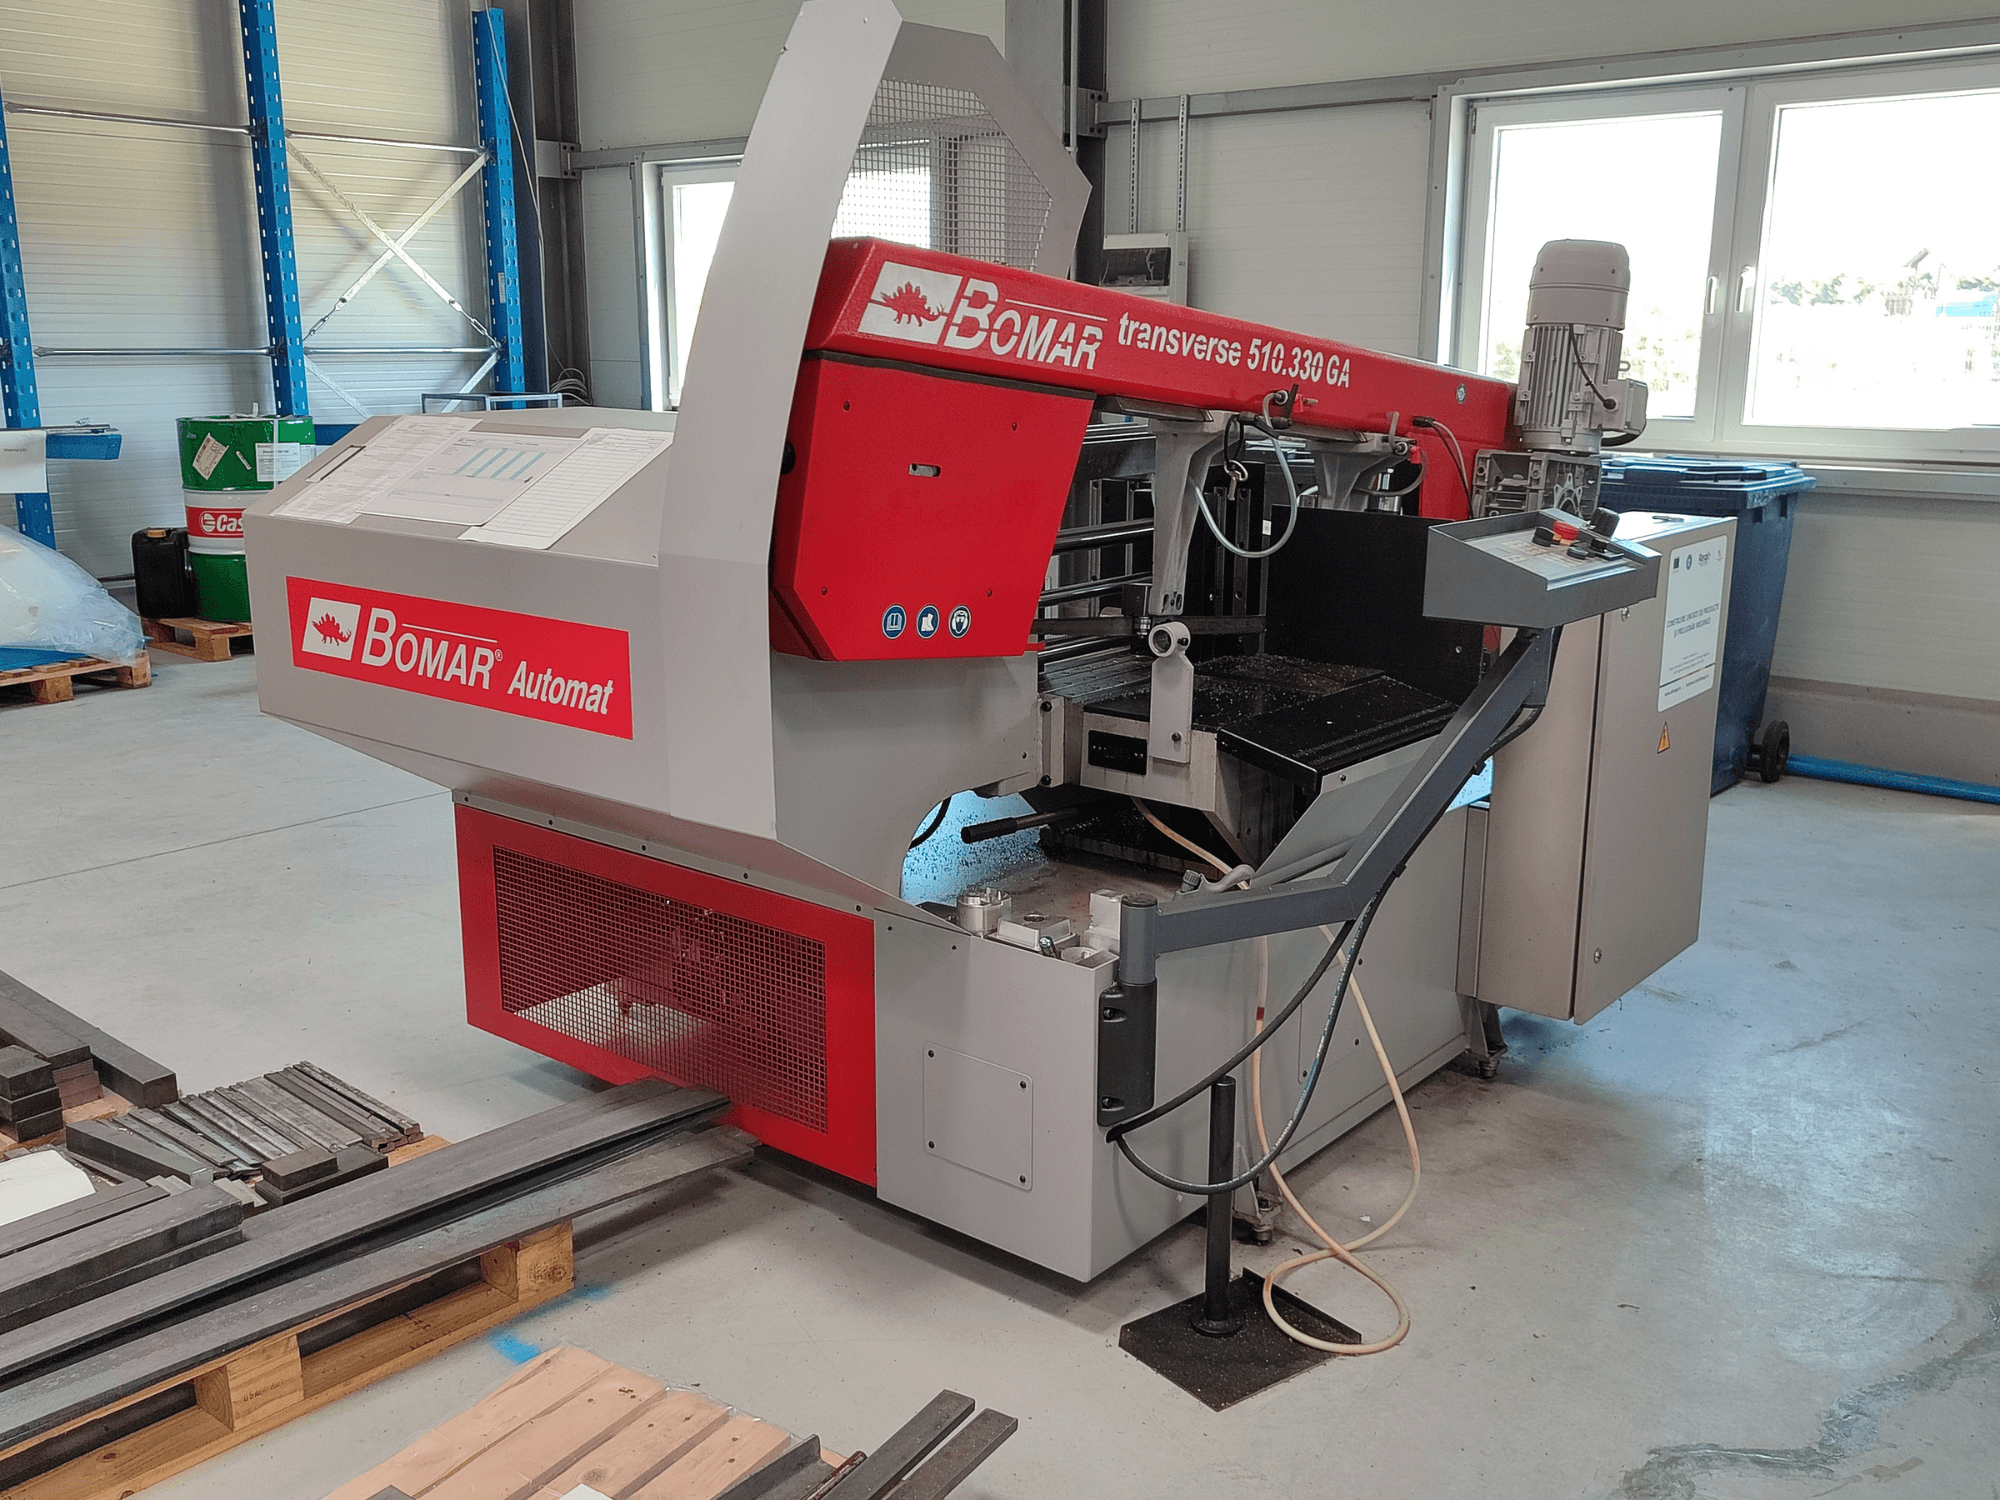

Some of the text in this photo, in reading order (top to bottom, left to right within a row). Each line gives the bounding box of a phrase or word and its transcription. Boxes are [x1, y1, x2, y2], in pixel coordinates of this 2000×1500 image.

[943, 277, 1351, 388] BOMAR transverse 510.330 GA
[507, 660, 614, 715] Automat
